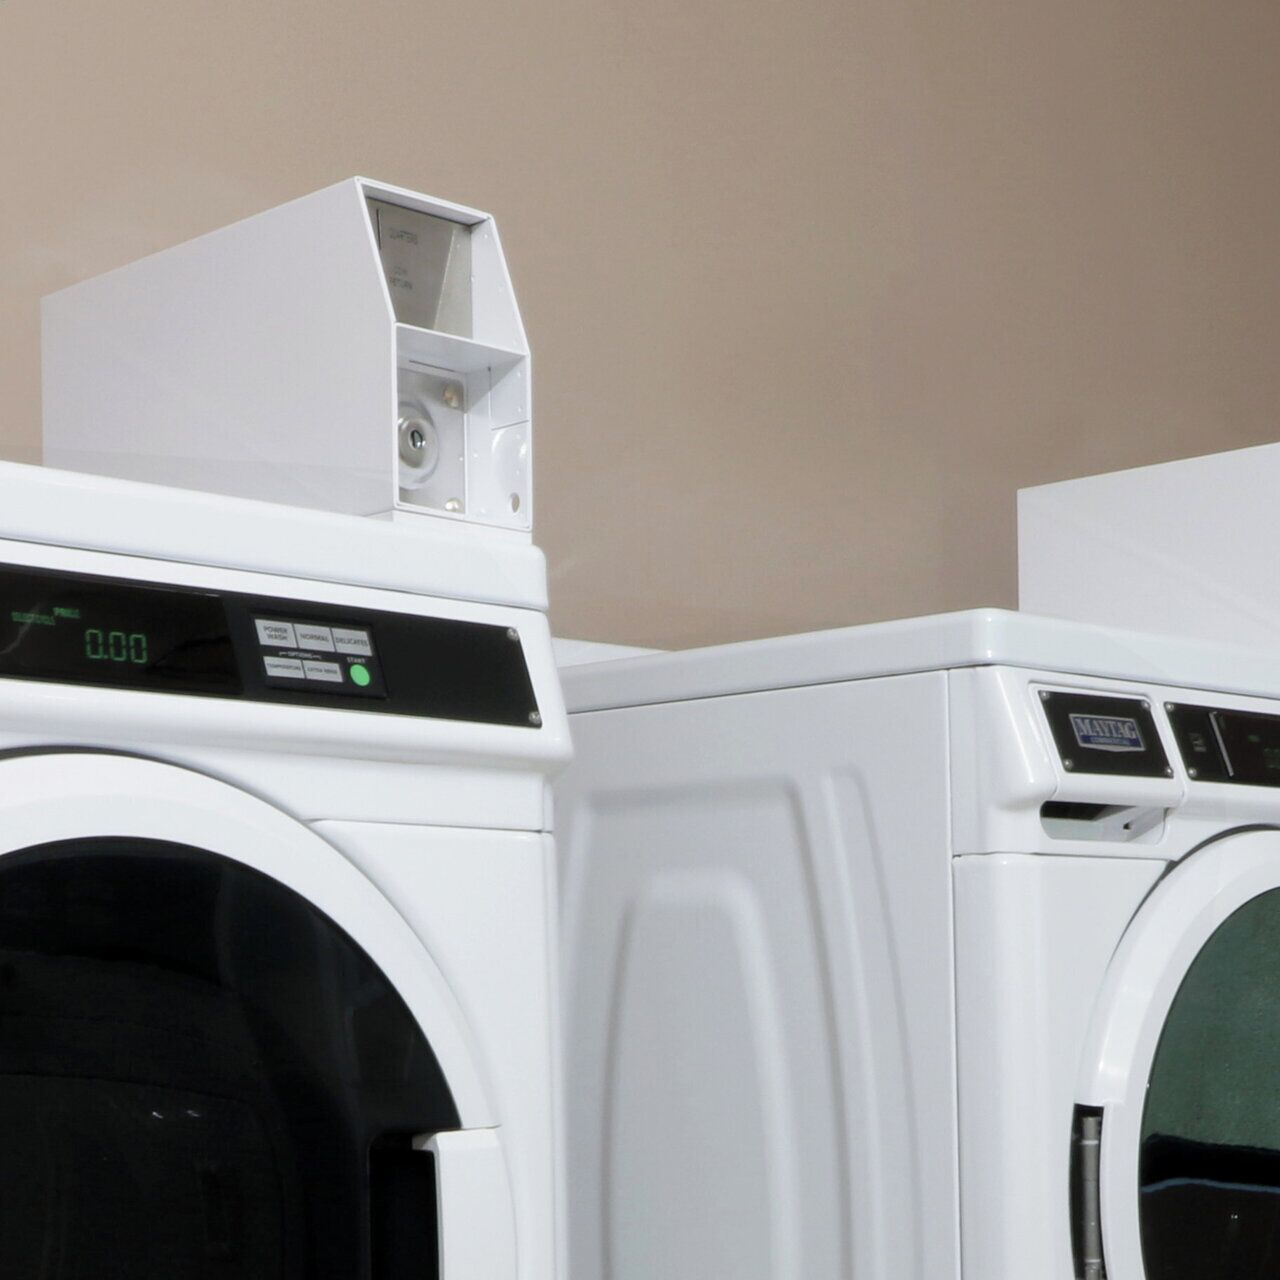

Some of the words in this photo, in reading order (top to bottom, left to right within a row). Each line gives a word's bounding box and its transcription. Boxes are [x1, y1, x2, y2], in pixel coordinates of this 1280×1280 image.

[263, 625, 288, 634] POWER
[267, 632, 288, 641] WASH
[299, 633, 329, 643] NORMAL
[84, 629, 148, 664] 0.00
[335, 637, 369, 647] DELICATES
[346, 656, 366, 664] START
[1074, 718, 1138, 739] MAYTAG
